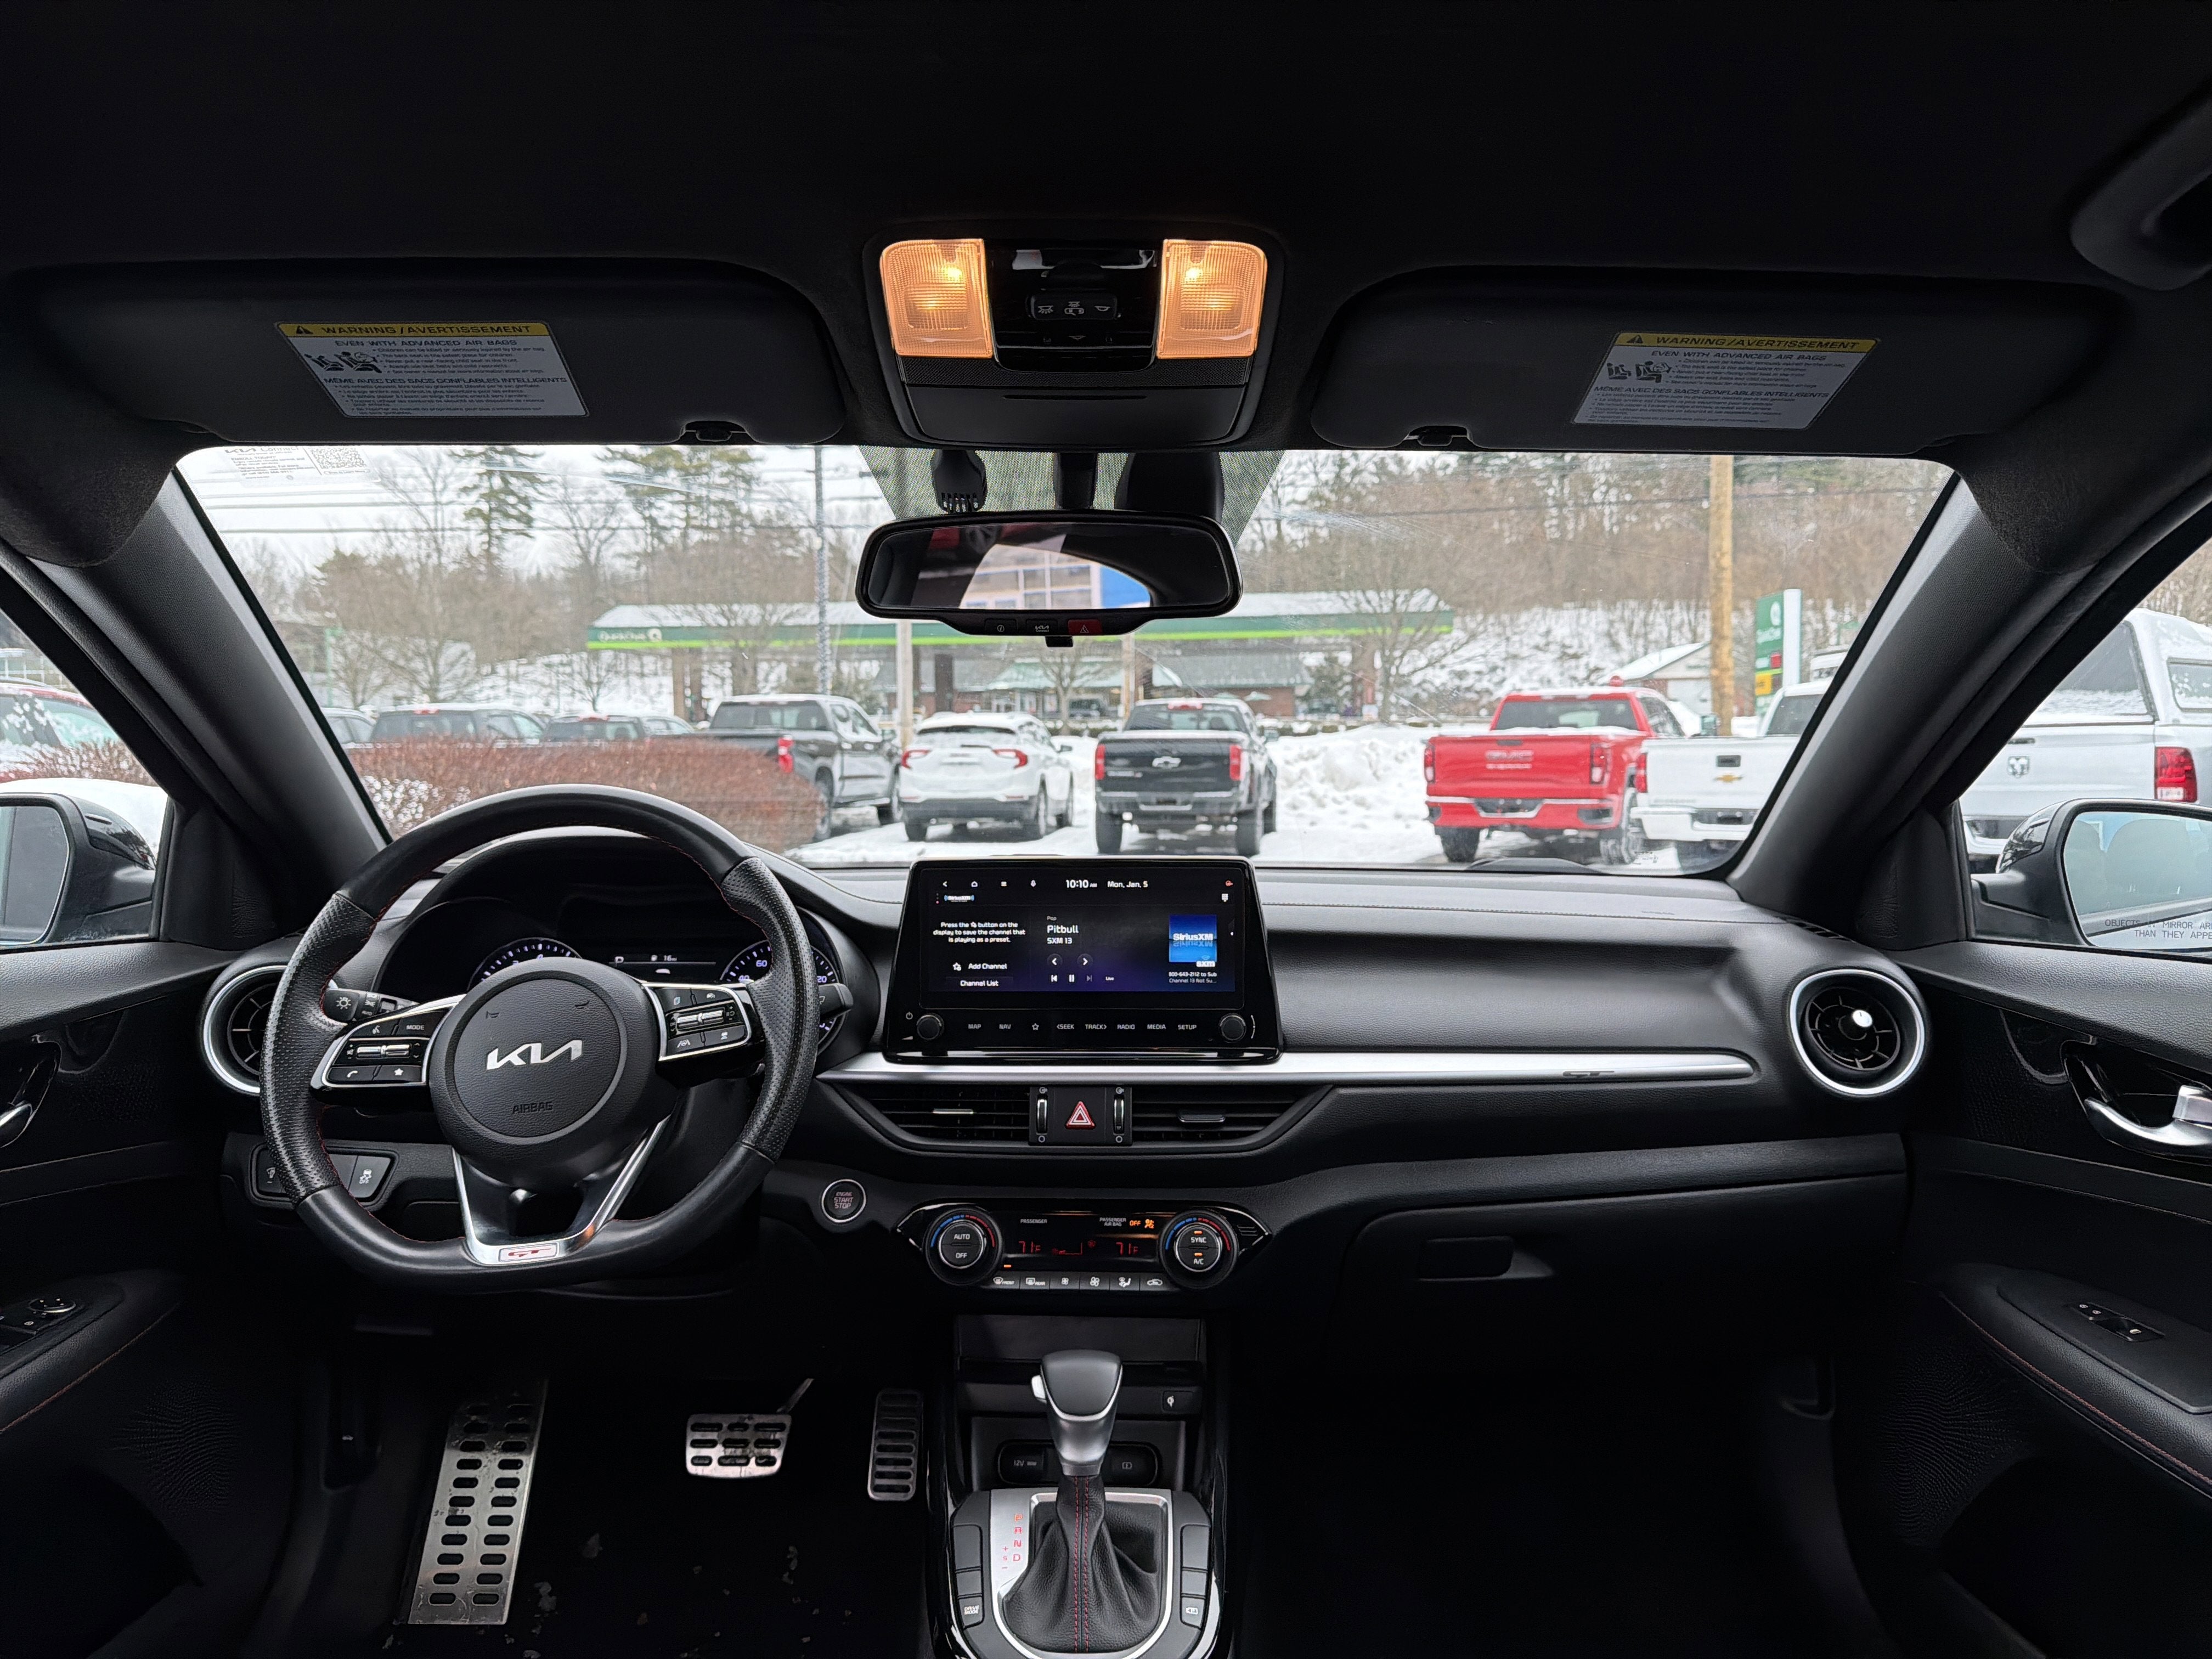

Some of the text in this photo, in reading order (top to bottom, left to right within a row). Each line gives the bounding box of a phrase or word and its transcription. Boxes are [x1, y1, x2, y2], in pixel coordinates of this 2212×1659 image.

[1066, 879, 1089, 888] 10:10
[1047, 925, 1079, 933] Pitbull
[2105, 919, 2141, 927] OBJECTS
[2199, 922, 2212, 930] AR
[2162, 930, 2185, 939] THEY
[614, 956, 624, 967] P
[487, 1040, 583, 1070] KIA
[512, 1101, 554, 1114] AIRBAG
[508, 1248, 551, 1257] GT
